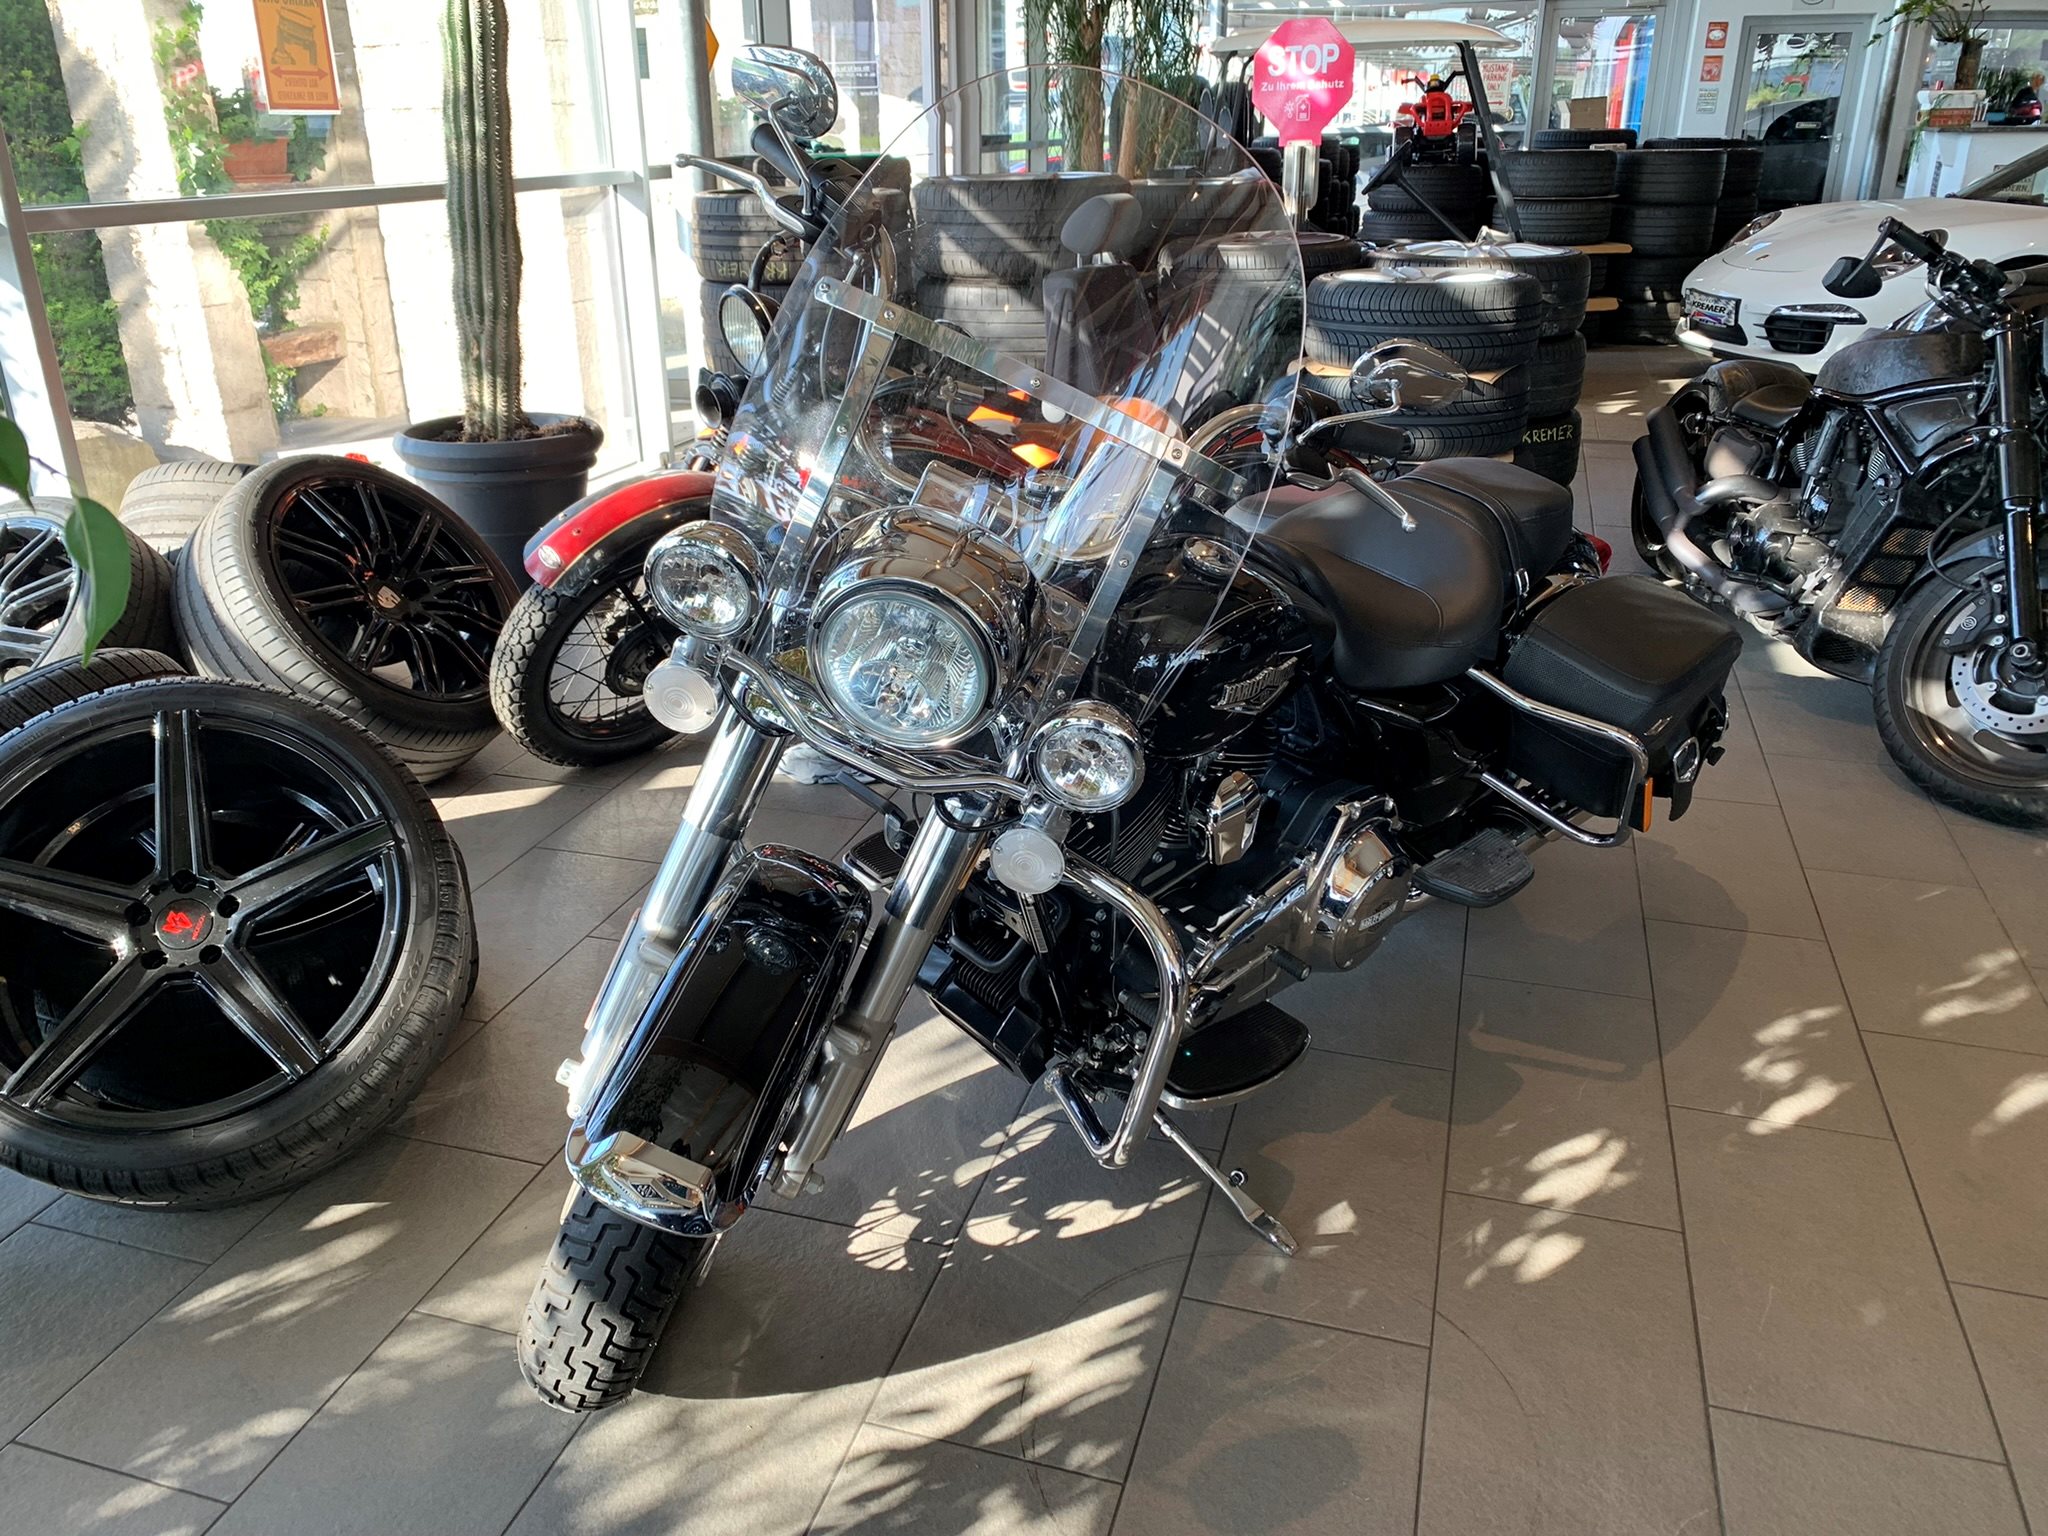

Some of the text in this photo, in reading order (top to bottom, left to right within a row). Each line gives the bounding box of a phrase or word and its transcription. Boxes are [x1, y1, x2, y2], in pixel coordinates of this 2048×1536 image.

[1267, 43, 1340, 77] STOP
[1482, 63, 1509, 73] MUSTANG
[1483, 72, 1507, 81] PARKING
[1260, 82, 1274, 92] Zu
[1487, 82, 1501, 91] ONLY
[716, 261, 788, 281] KRMER
[1692, 300, 1727, 314] KREMER
[1522, 424, 1574, 444] KREMER
